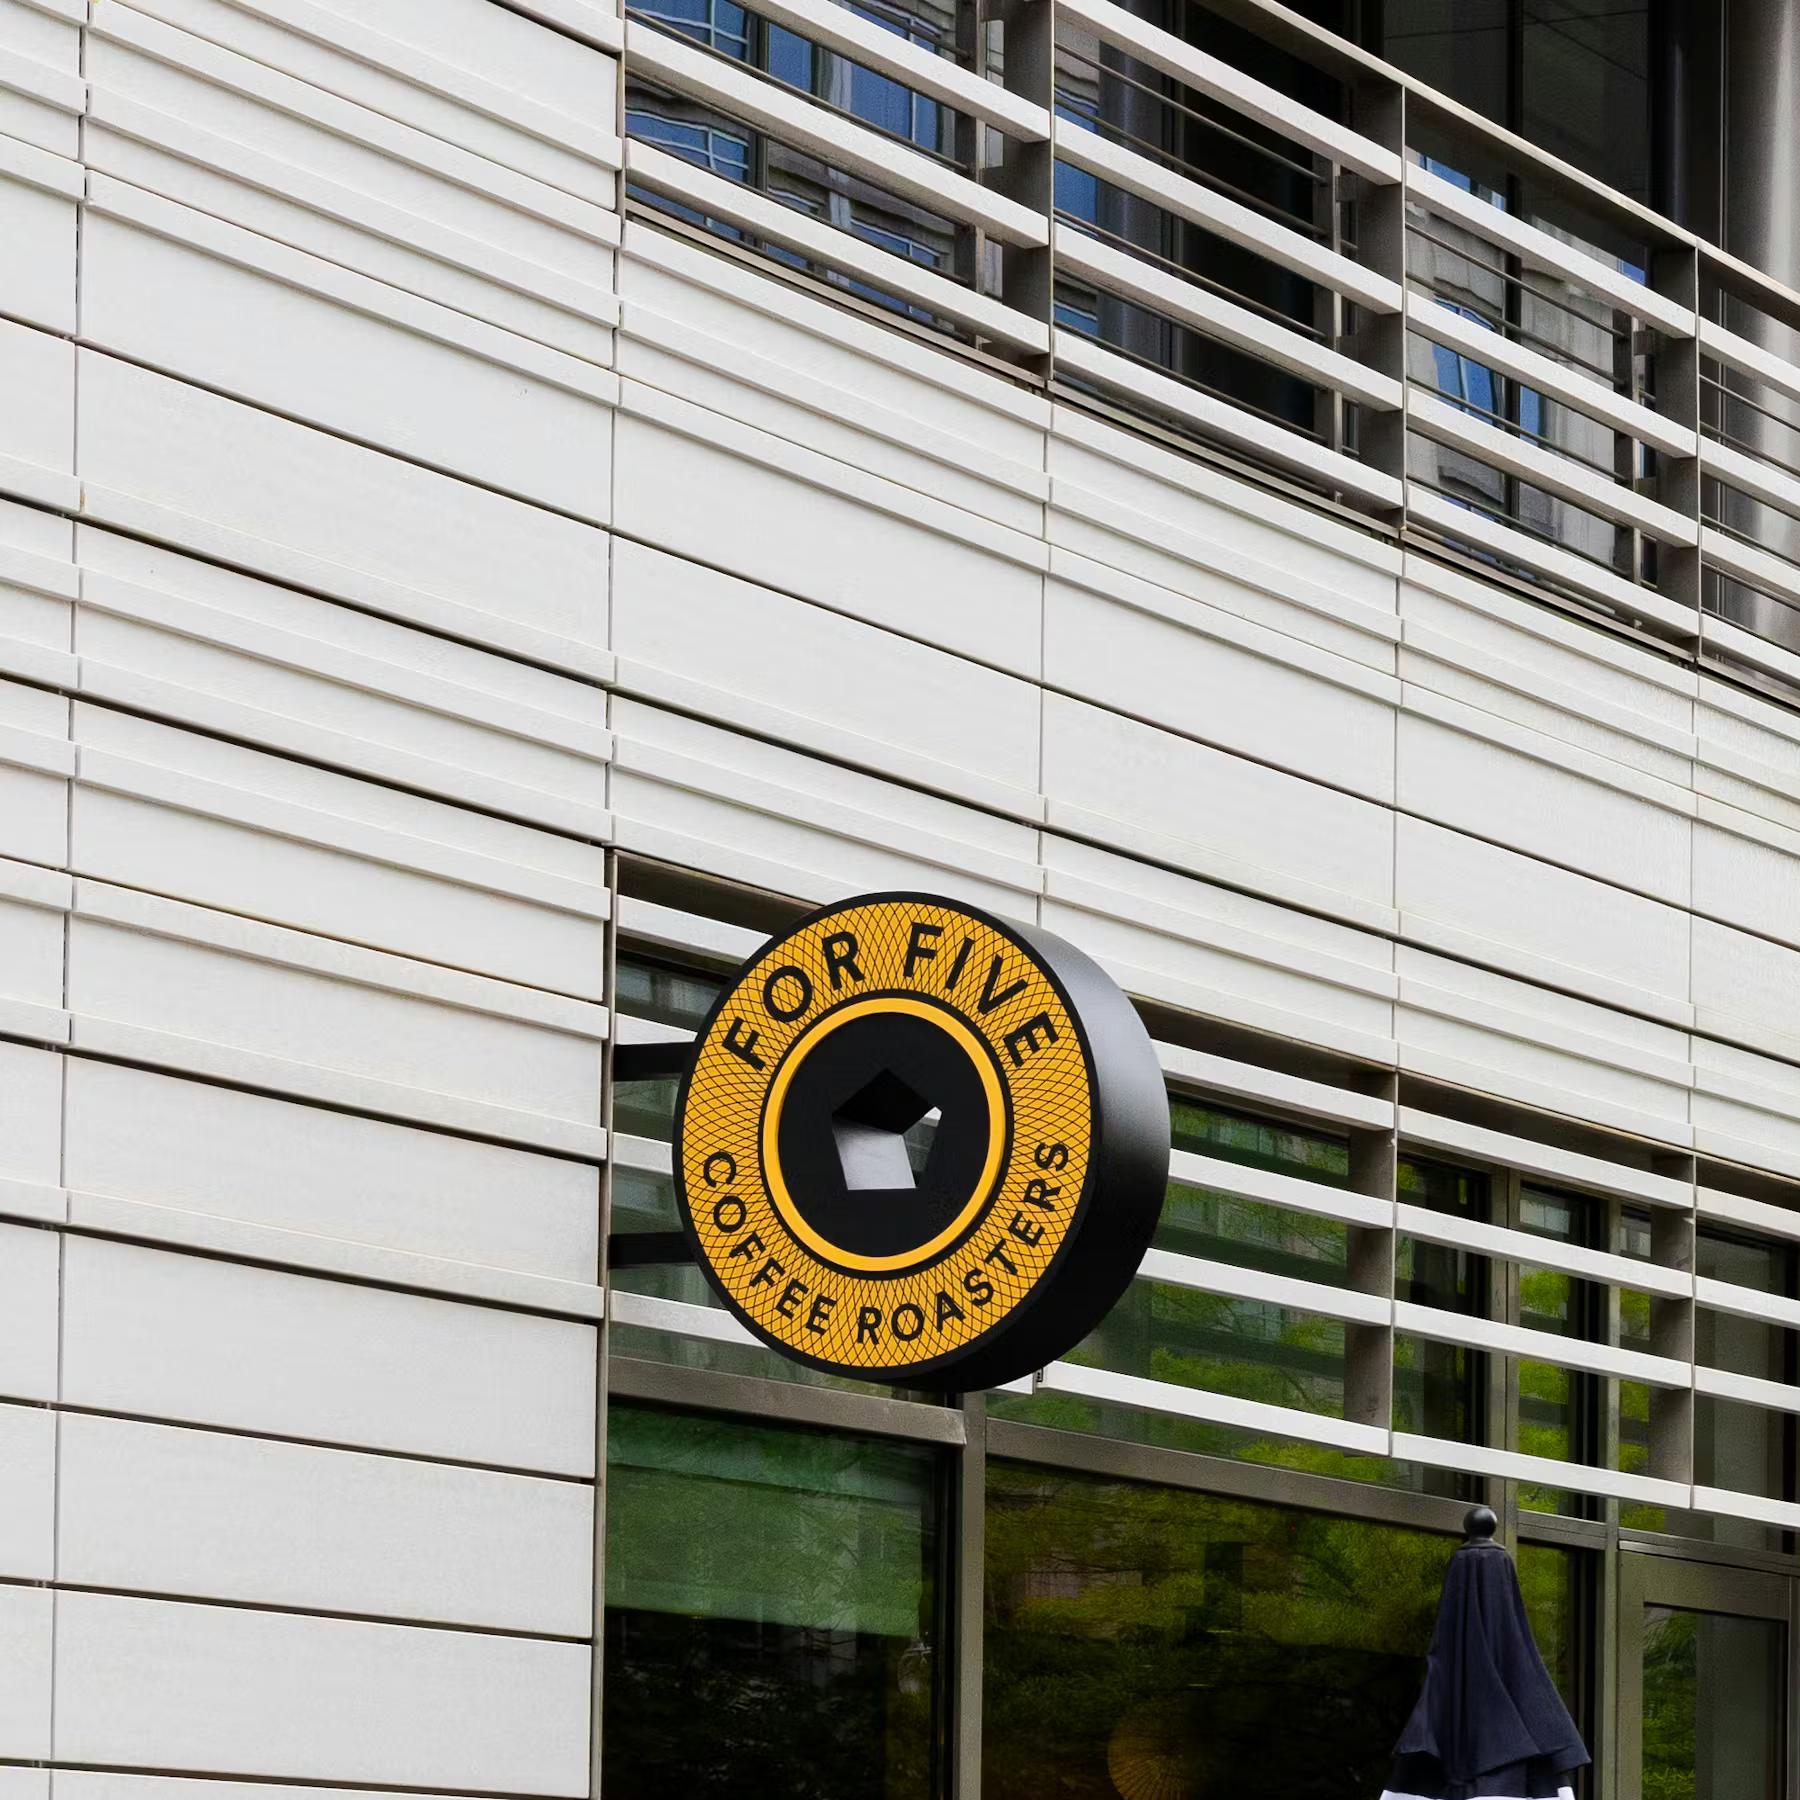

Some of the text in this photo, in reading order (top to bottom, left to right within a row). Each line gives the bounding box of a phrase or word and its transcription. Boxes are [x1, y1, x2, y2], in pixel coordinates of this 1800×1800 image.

[721, 922, 1058, 1072] FOR FIVE
[704, 1142, 1069, 1346] COFFEE ROASTERS
